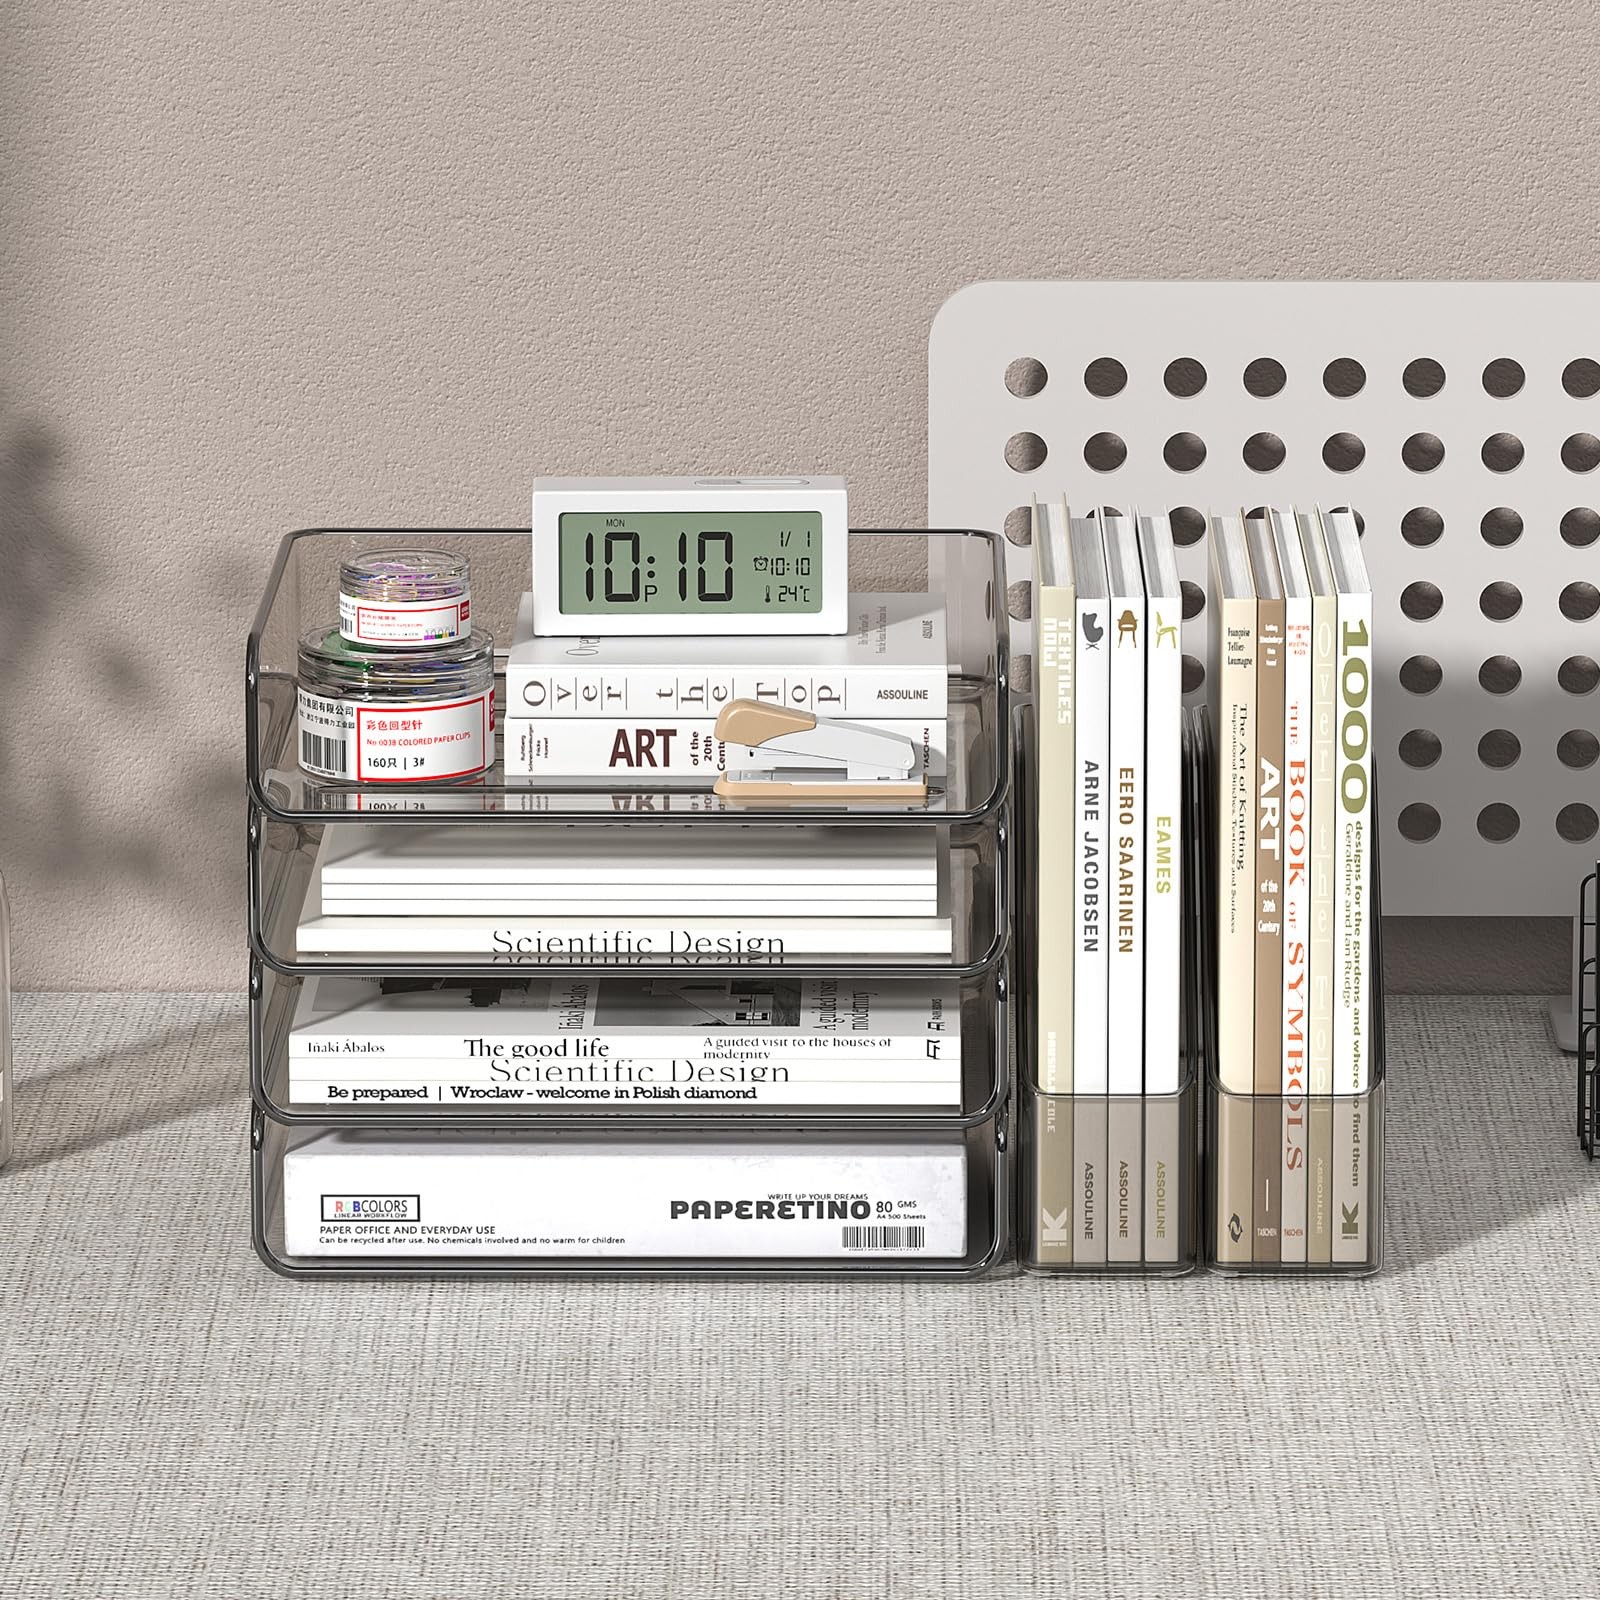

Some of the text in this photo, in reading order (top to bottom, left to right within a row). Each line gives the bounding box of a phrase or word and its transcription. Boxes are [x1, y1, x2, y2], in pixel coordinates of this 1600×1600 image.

[606, 519, 625, 528] MON
[586, 532, 733, 602] 10:10
[770, 558, 811, 576] 10:10
[645, 585, 657, 602] P
[1057, 617, 1072, 725] TEXTILES
[523, 681, 841, 706] Over the Top
[877, 690, 928, 699] ASSOULINE
[1318, 622, 1332, 773] Over
[366, 720, 423, 730] 彩色回型针
[1240, 703, 1248, 736] The
[1341, 618, 1369, 814] 1000
[398, 737, 433, 747] COLORED
[434, 735, 454, 744] PAPER
[455, 731, 471, 741] CLIPS
[609, 729, 677, 767] ART
[690, 731, 699, 766] of the
[704, 736, 712, 761] 20th
[368, 758, 398, 768] 160只
[1240, 776, 1247, 794] of
[1260, 757, 1280, 860] ART
[1236, 800, 1247, 870] Knitting
[1084, 760, 1099, 952] ARNE JACOBSEN
[1118, 767, 1134, 953] EERO SAARINEN
[1156, 816, 1172, 894] EAMES
[1353, 820, 1363, 881] designs
[1354, 885, 1363, 908] for
[1343, 823, 1354, 1009] Geraldine and Ian Rudge
[1354, 910, 1362, 937] the
[492, 930, 784, 953] Scientific Design
[1286, 701, 1306, 1170] THE BOOK OF SYMBOLS
[1352, 940, 1362, 1003] gardens
[1353, 1007, 1361, 1036] and
[464, 1038, 609, 1059] The good life
[704, 1037, 891, 1050] A guided visit to the houses of
[704, 1049, 770, 1061] modernity
[490, 1059, 789, 1081] Scientific Design
[1352, 1040, 1361, 1088] where
[328, 1086, 348, 1098] Be
[352, 1085, 428, 1101] prepared
[450, 1085, 524, 1099] Wroclaw
[535, 1086, 610, 1099] welcome
[614, 1086, 630, 1099] in
[633, 1086, 680, 1099] Polish
[684, 1086, 757, 1099] diamond
[1352, 1113, 1361, 1144] find
[1352, 1147, 1361, 1187] them
[671, 1200, 871, 1219] PAPERETINO
[876, 1201, 893, 1213] 80
[1084, 1162, 1094, 1240] ASSOULINE
[1119, 1160, 1129, 1239] ASSOULINE
[1156, 1160, 1166, 1239] ASSOULINE
[319, 1236, 335, 1244] Can
[338, 1236, 348, 1244] be
[351, 1236, 384, 1246] recycled
[387, 1236, 406, 1244] after
[427, 1236, 440, 1244] No
[442, 1236, 482, 1244] chemicals
[485, 1236, 519, 1244] involved
[522, 1236, 537, 1244] and
[578, 1236, 590, 1244] for
[592, 1236, 625, 1244] children
[320, 1226, 496, 1235] PAPER OFFICE AND EVERYDAY USE
